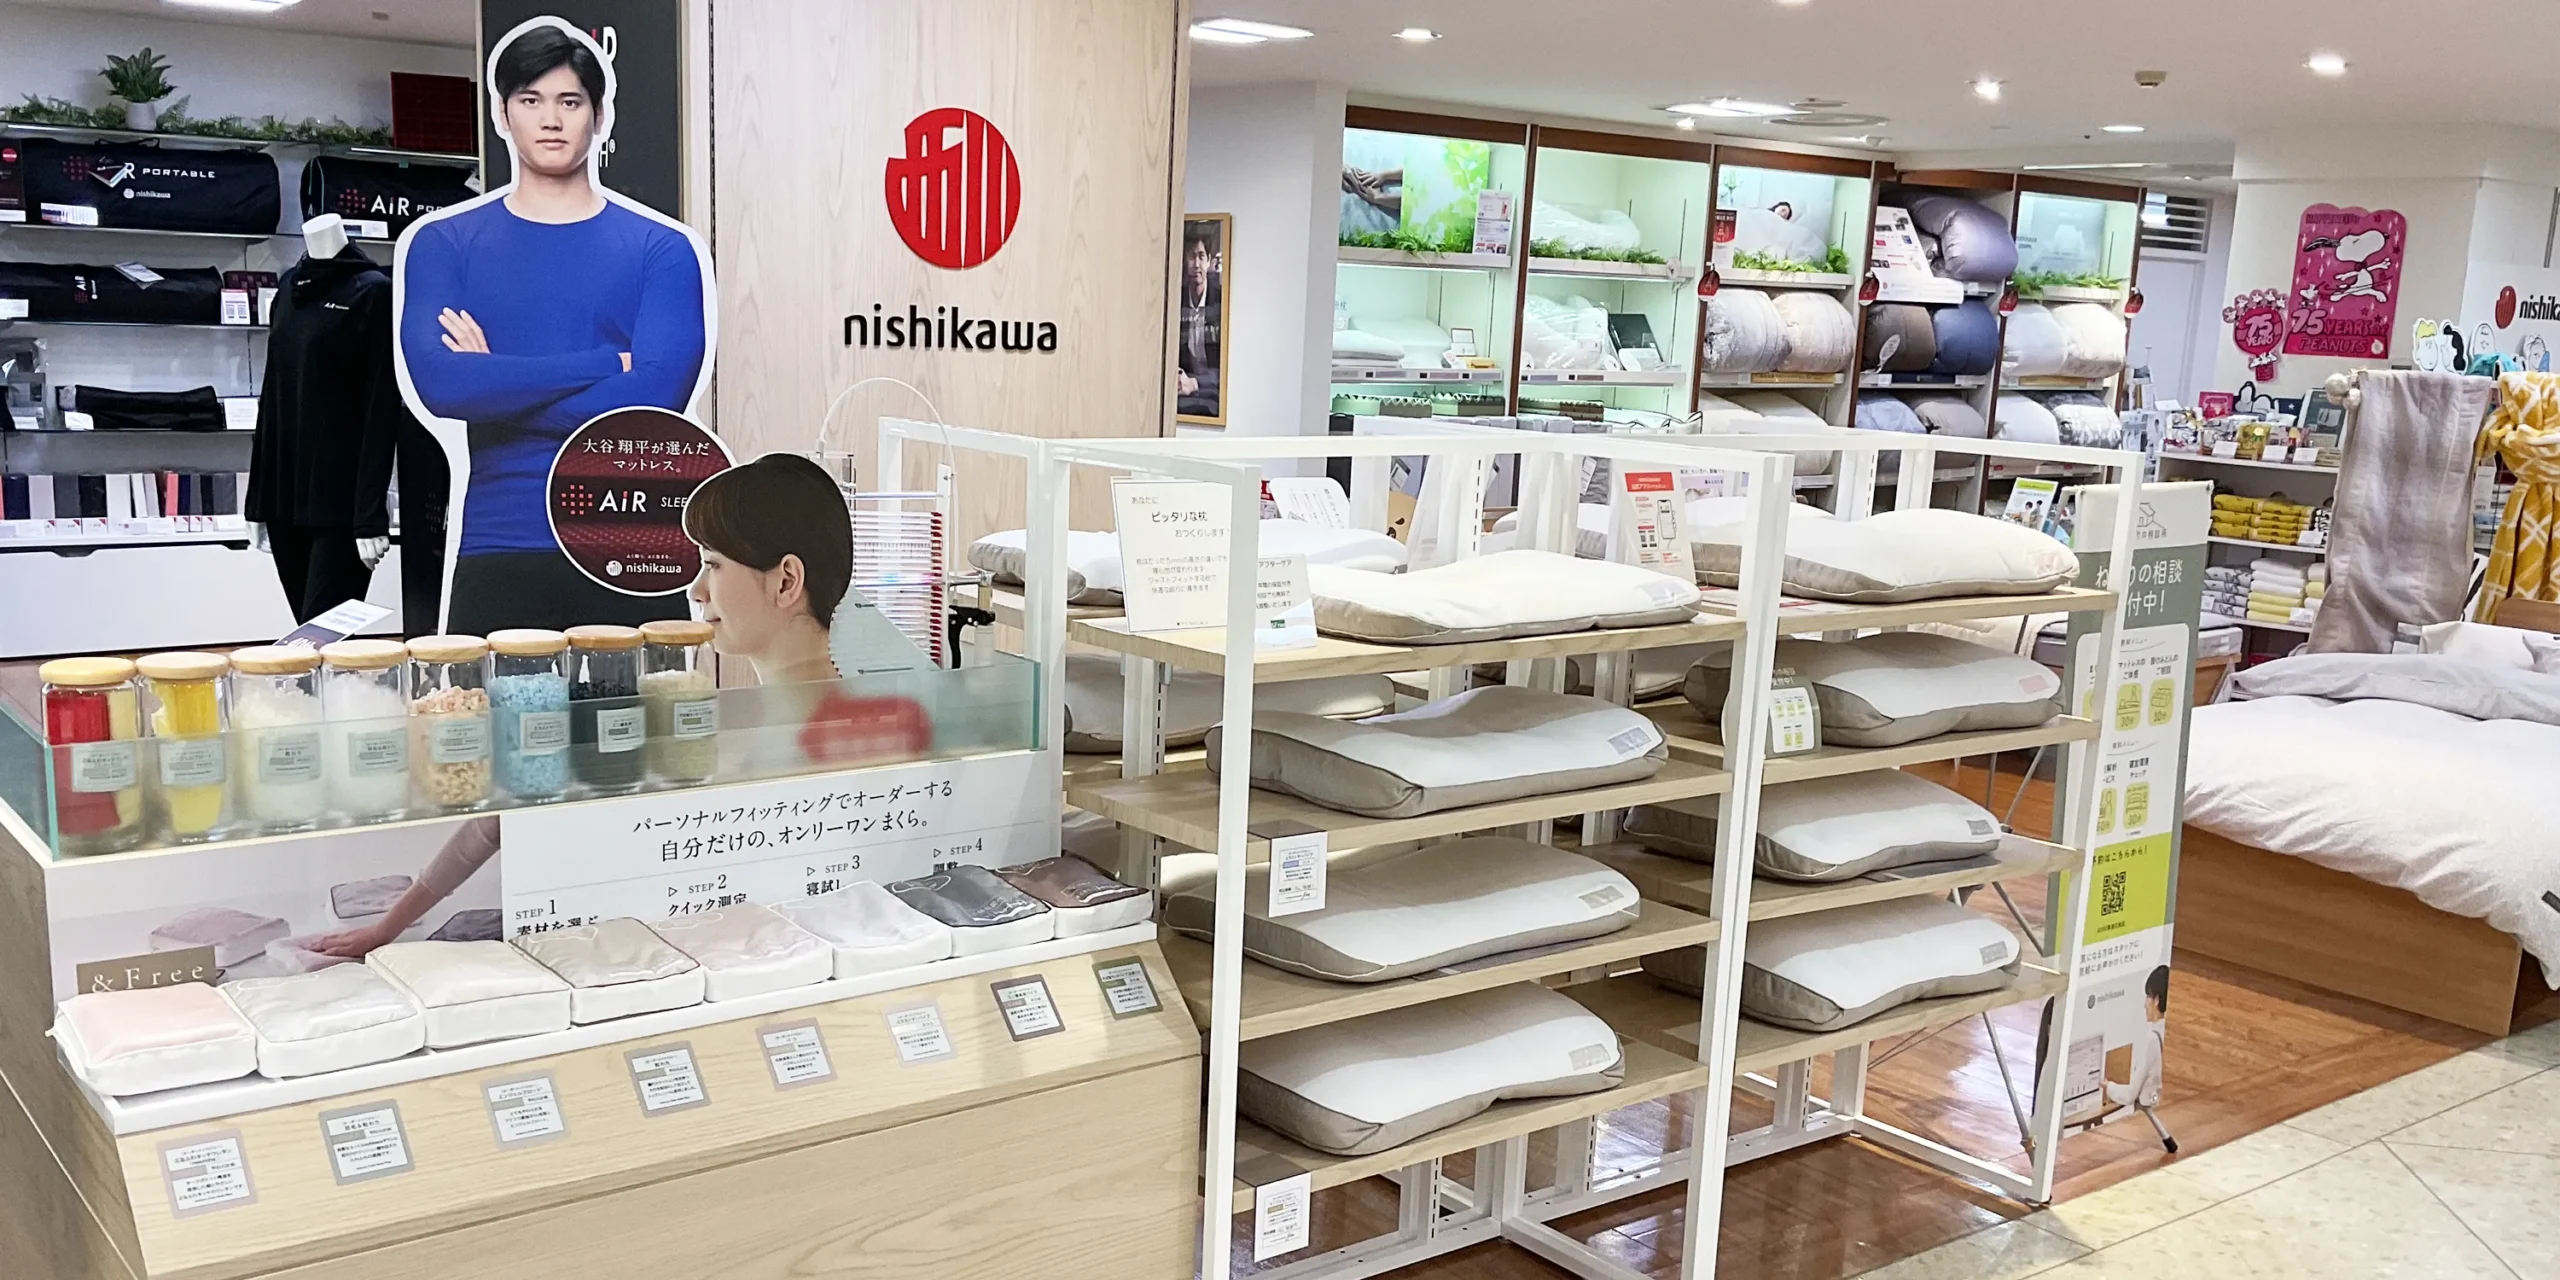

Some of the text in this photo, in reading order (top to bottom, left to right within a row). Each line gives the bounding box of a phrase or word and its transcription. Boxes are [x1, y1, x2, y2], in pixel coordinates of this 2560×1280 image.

[142, 167, 216, 179] PORTABLE
[136, 190, 171, 199] nishikawa
[844, 303, 1058, 352] nishikawa
[2292, 308, 2328, 335] 75
[2325, 318, 2371, 336] YEARS
[2300, 334, 2368, 354] PEANUTS
[582, 438, 710, 456] 大谷翔平が選んだ
[613, 458, 681, 474] マットレス。
[626, 562, 682, 574] nishikawa
[632, 780, 953, 833] パーソナルフィッティングでオーダーする
[661, 809, 929, 863] 自分だけの、オンリーワンまくら。
[950, 837, 983, 855] STEP 4
[825, 855, 861, 874] STEP 3
[688, 873, 727, 894] STEP 2
[515, 899, 557, 920] STEP 1
[91, 965, 204, 993] & Free
